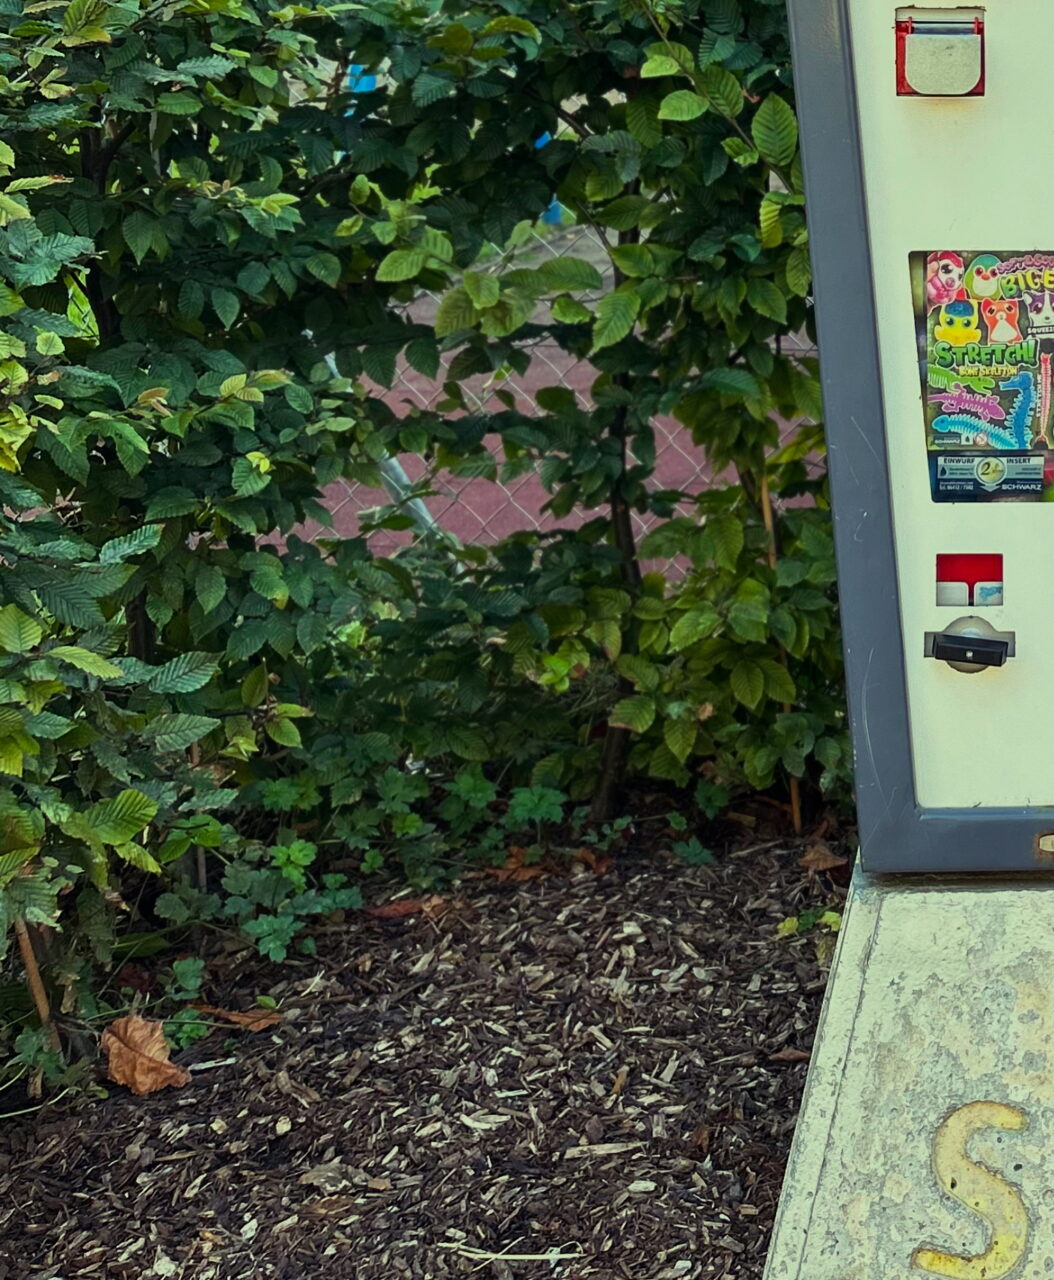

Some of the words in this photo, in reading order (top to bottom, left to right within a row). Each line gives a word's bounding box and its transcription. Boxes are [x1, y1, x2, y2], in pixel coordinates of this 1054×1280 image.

[1001, 272, 1038, 296] BIG
[1027, 326, 1053, 334] SQUEEZE
[935, 339, 1035, 366] STRETCH!
[981, 462, 990, 475] 2
